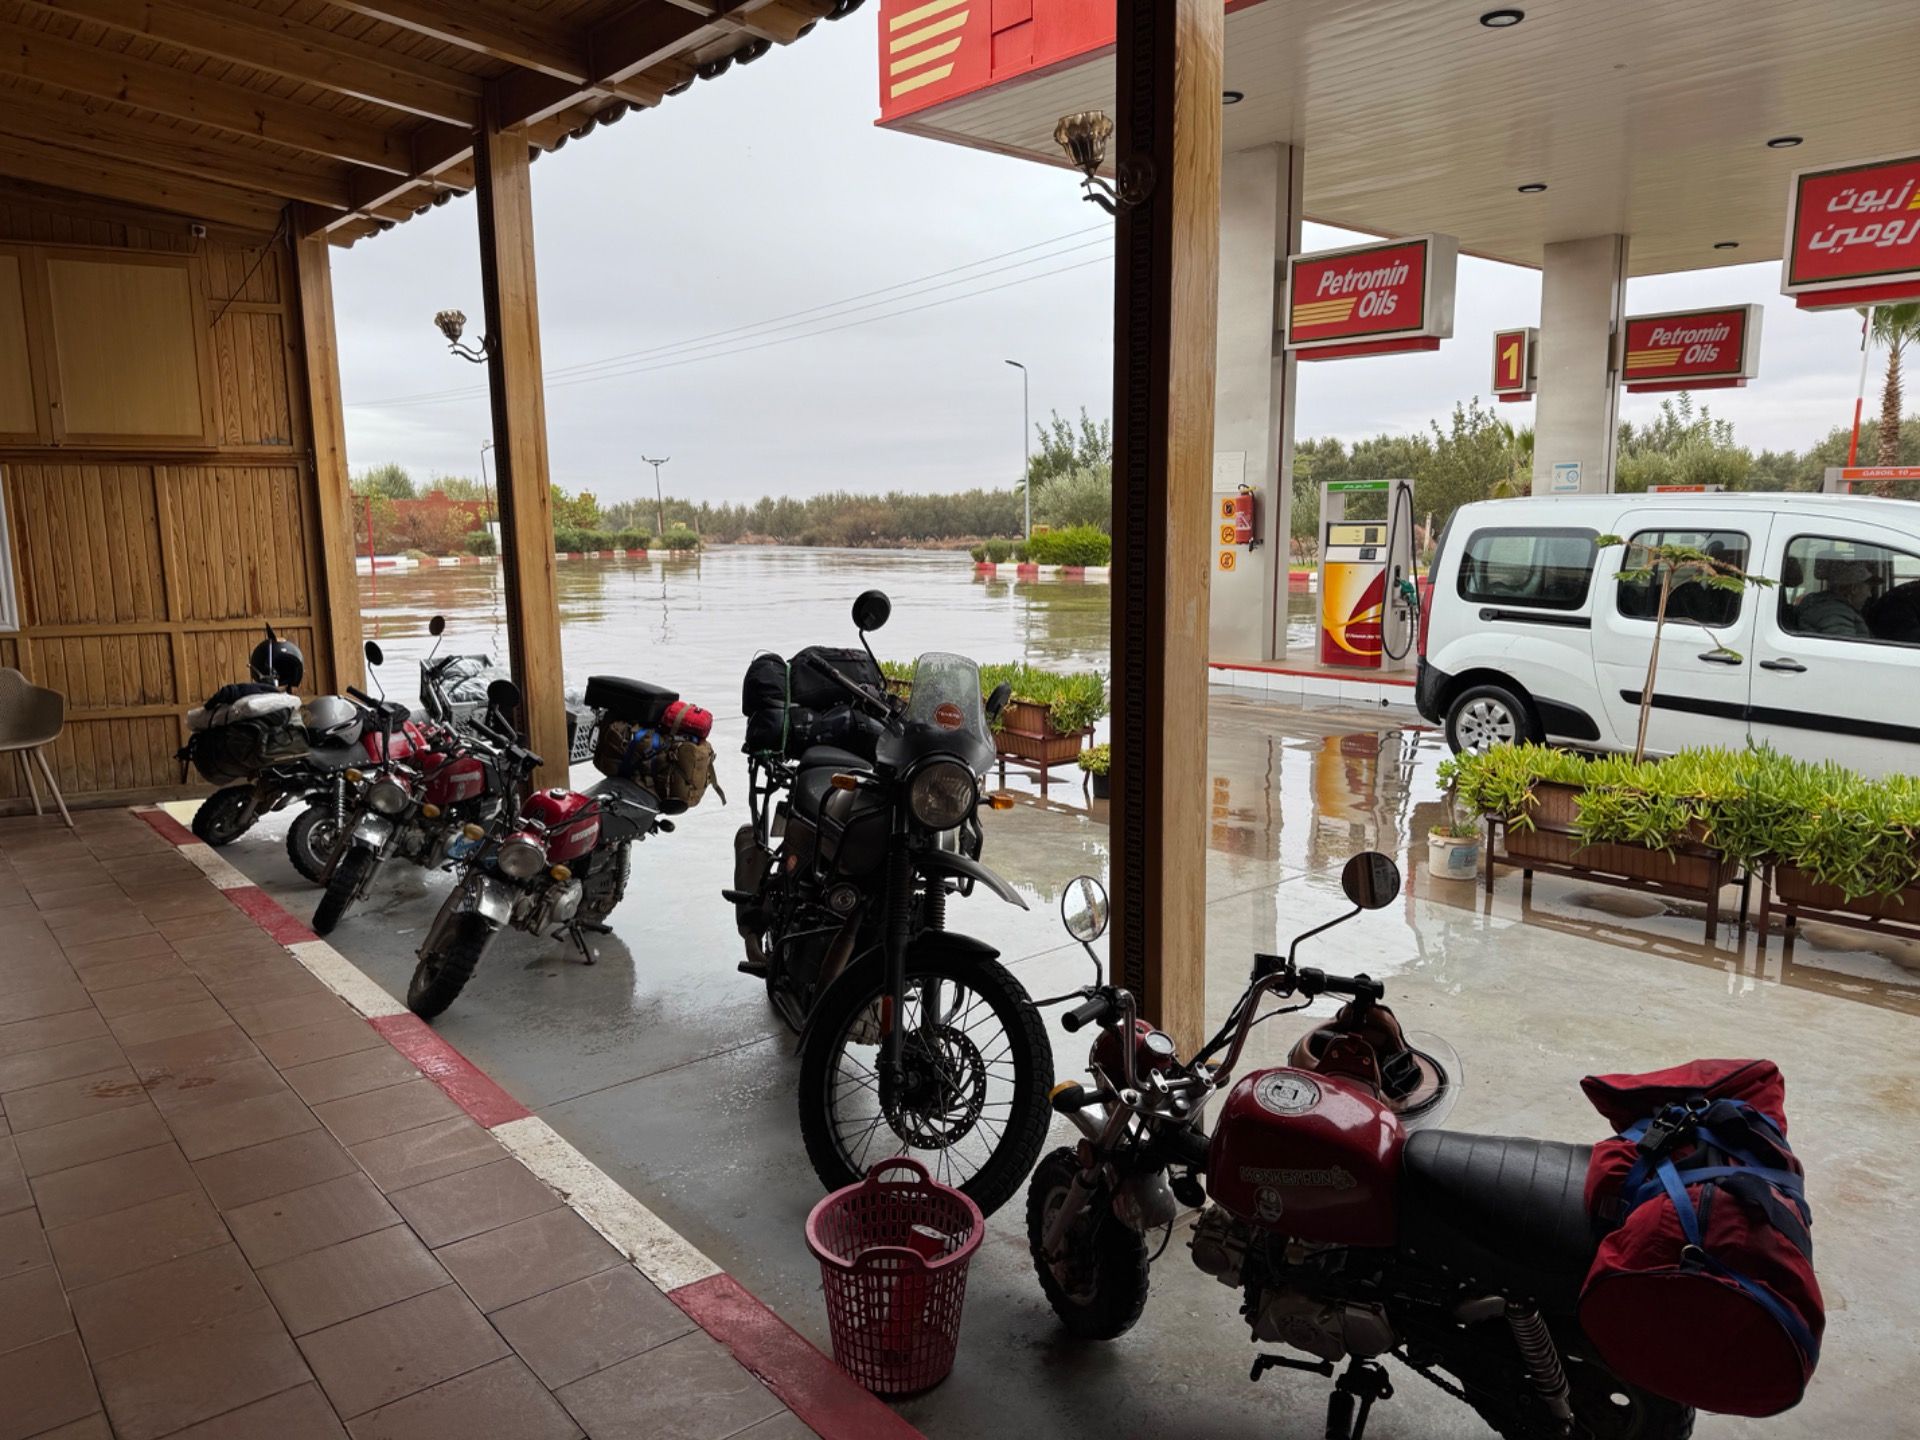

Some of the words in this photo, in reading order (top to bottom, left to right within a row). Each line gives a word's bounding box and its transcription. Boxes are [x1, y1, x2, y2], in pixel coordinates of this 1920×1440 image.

[1827, 179, 1915, 213] زيوت
[1808, 218, 1920, 254] رومين
[1316, 260, 1409, 297] Petromin
[1358, 289, 1399, 318] Oils
[1648, 322, 1730, 347] Petromin
[1502, 342, 1519, 380] 1
[1684, 344, 1720, 364] Oils
